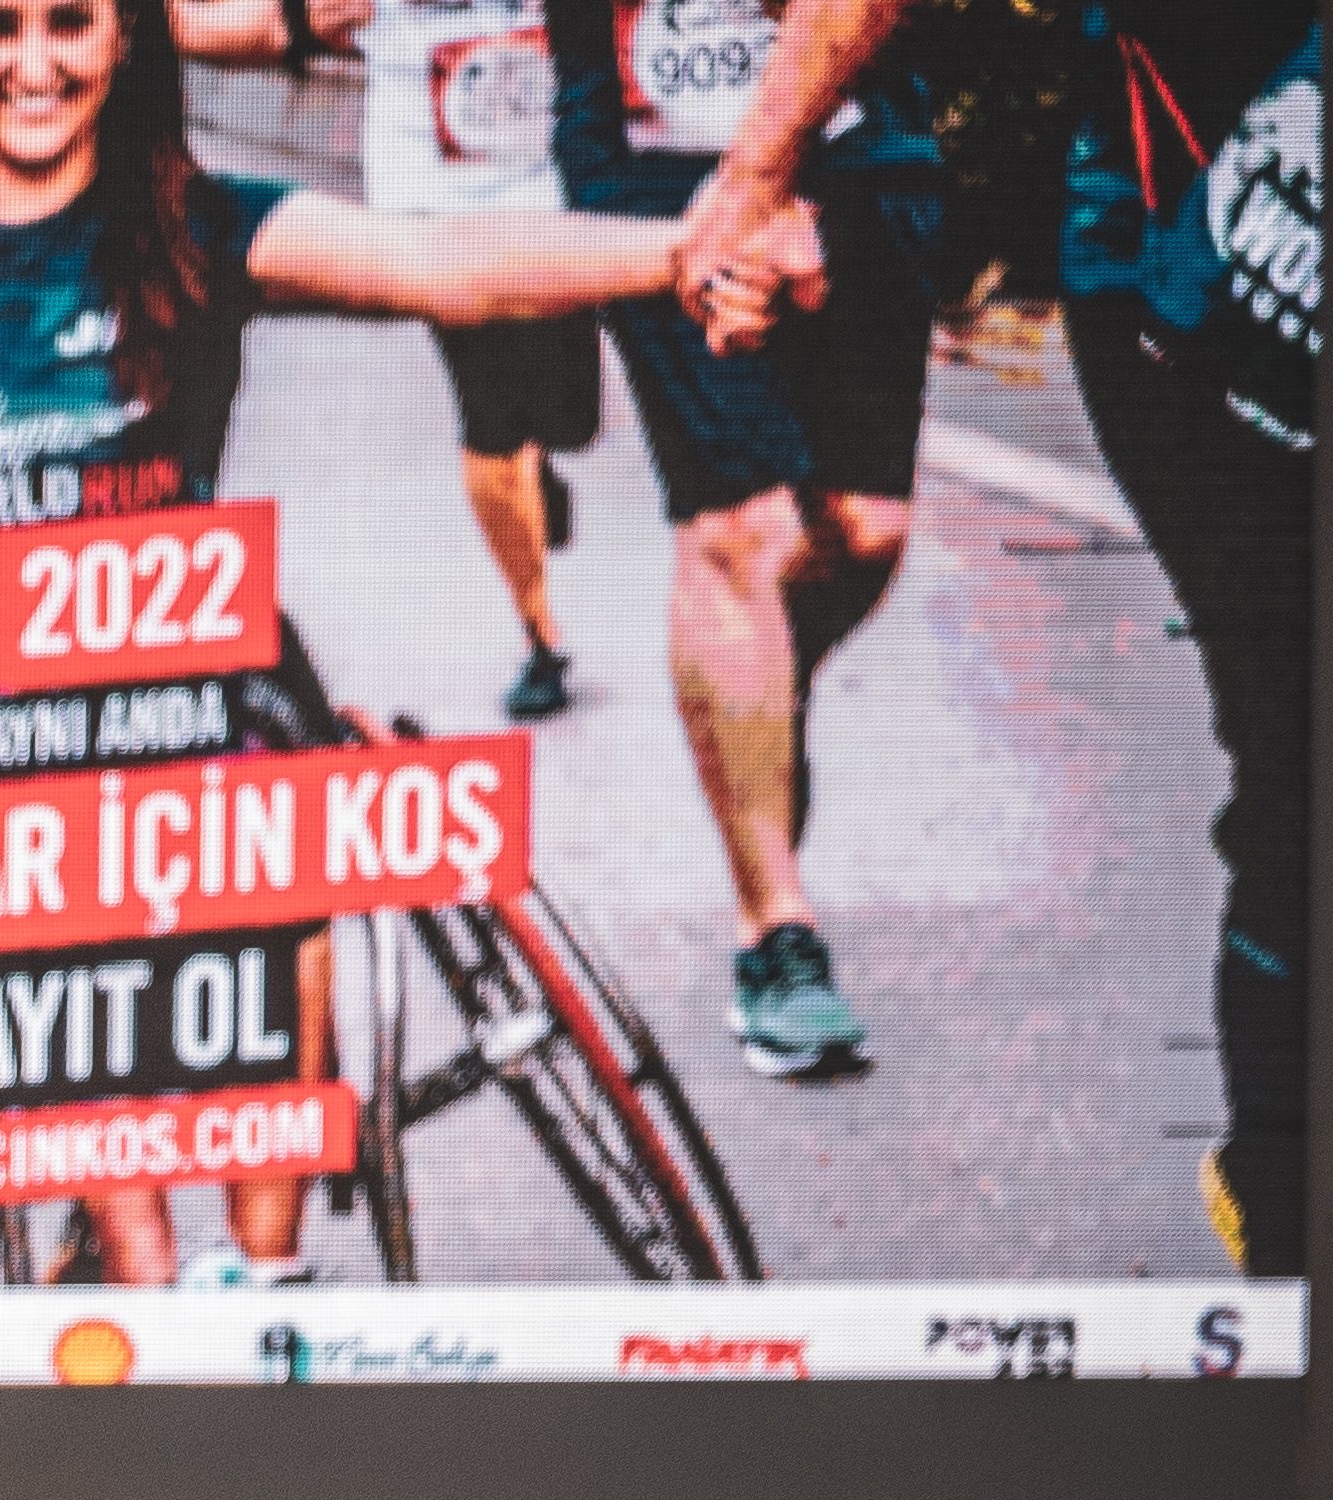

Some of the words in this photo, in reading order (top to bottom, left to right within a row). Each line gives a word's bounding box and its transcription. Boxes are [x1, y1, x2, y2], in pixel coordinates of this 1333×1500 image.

[20, 529, 247, 661] 2022
[96, 680, 229, 757] ANDA
[98, 765, 297, 936] İÇİN
[323, 760, 504, 906] KOŞ
[171, 948, 290, 1068] OL
